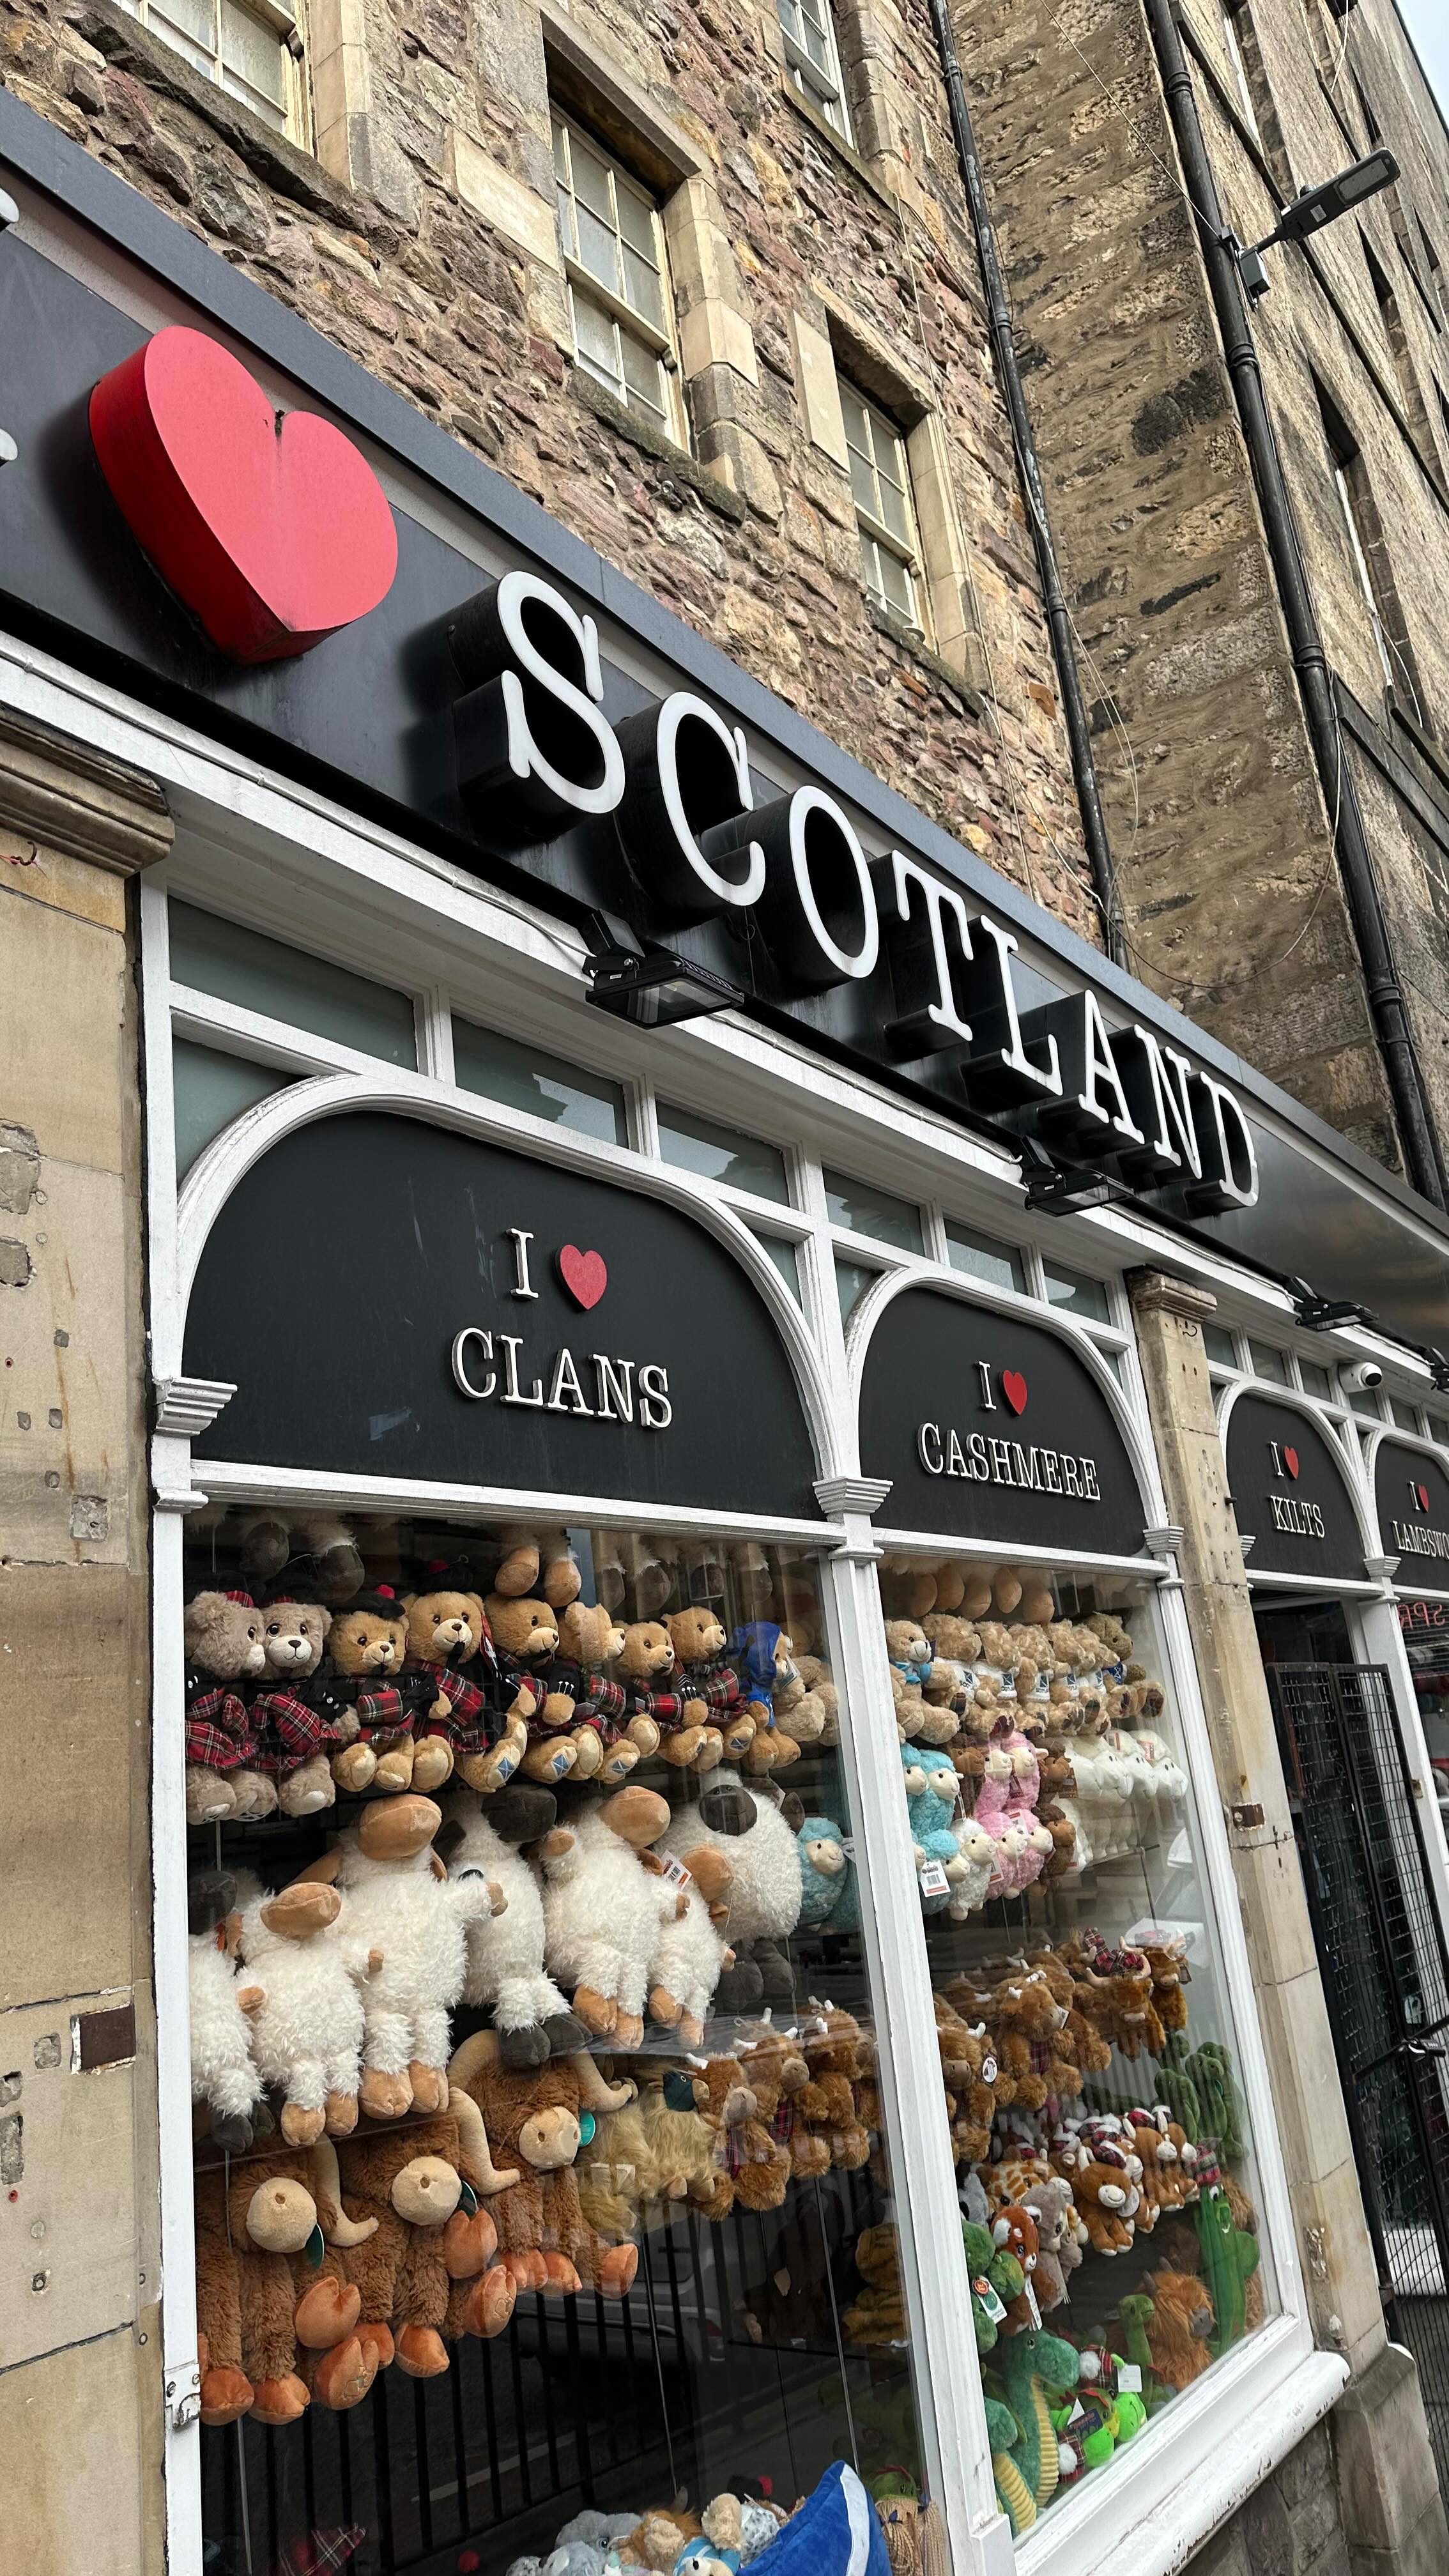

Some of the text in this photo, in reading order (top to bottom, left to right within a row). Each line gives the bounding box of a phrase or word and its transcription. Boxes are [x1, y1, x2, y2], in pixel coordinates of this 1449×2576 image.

[497, 571, 1259, 1208] SCOTLAND
[506, 1227, 539, 1300] I
[451, 1327, 672, 1429] CLANS
[977, 1360, 997, 1411] I
[917, 1422, 1101, 1501] CASHMERE
[1269, 1441, 1284, 1476] I
[1269, 1496, 1324, 1538] KILTS
[1409, 1480, 1420, 1511] I
[1392, 1521, 1449, 1560] LAMBSWO
